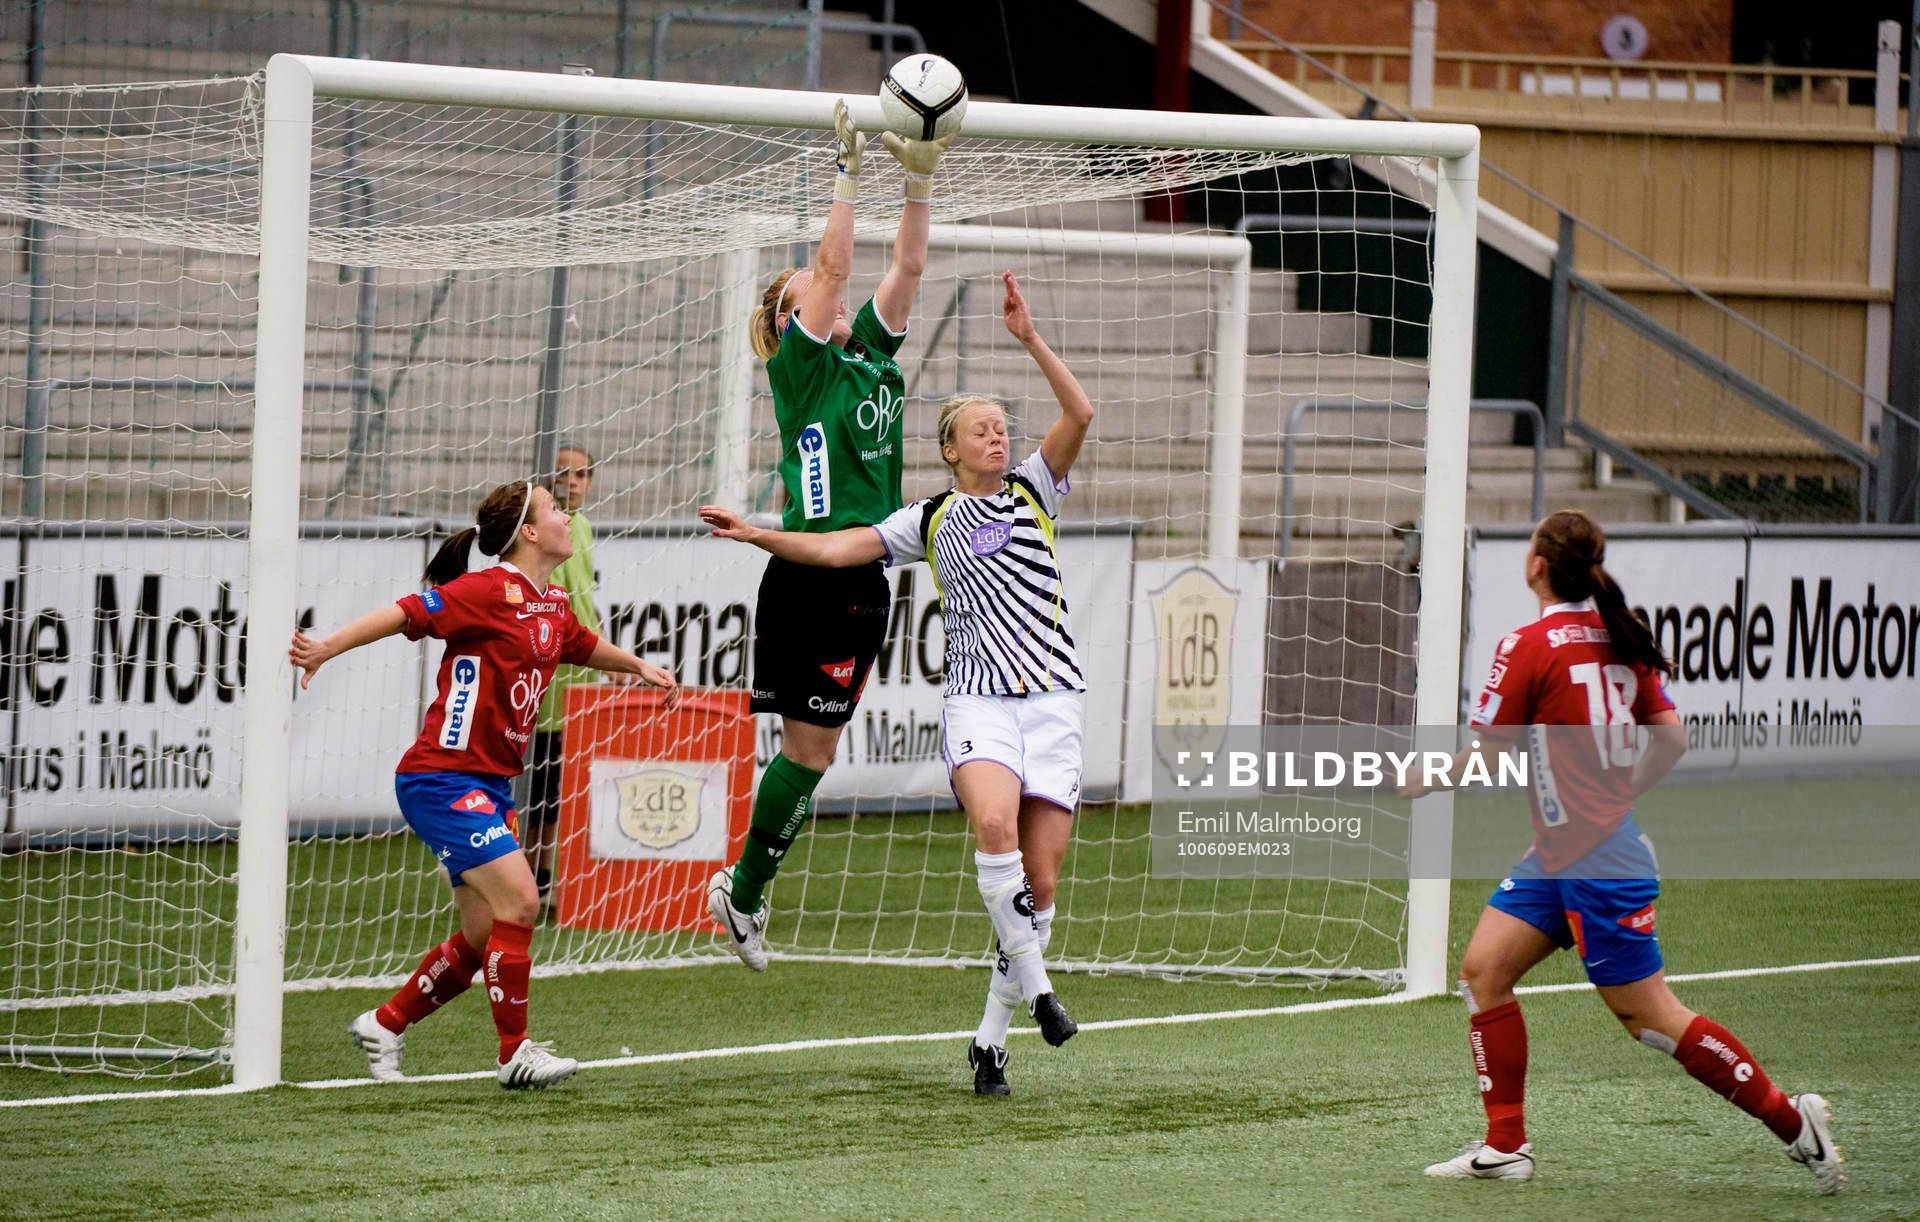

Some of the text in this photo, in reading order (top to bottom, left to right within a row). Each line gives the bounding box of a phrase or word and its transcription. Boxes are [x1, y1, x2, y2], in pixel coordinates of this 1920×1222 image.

[801, 427, 825, 516] e-man
[976, 526, 1006, 544] LdB
[89, 573, 315, 705] Mot
[594, 568, 751, 693] rena
[1167, 612, 1219, 688] LdB
[1633, 576, 1775, 683] nade
[445, 658, 477, 746] e-man
[865, 709, 947, 766] Malm
[1569, 661, 1638, 770] 18
[1776, 699, 1784, 747] i
[1789, 697, 1863, 748] Malmö
[0, 746, 64, 792] us
[100, 729, 214, 790] Malmö
[960, 740, 973, 754] 3
[631, 783, 688, 813] LdB
